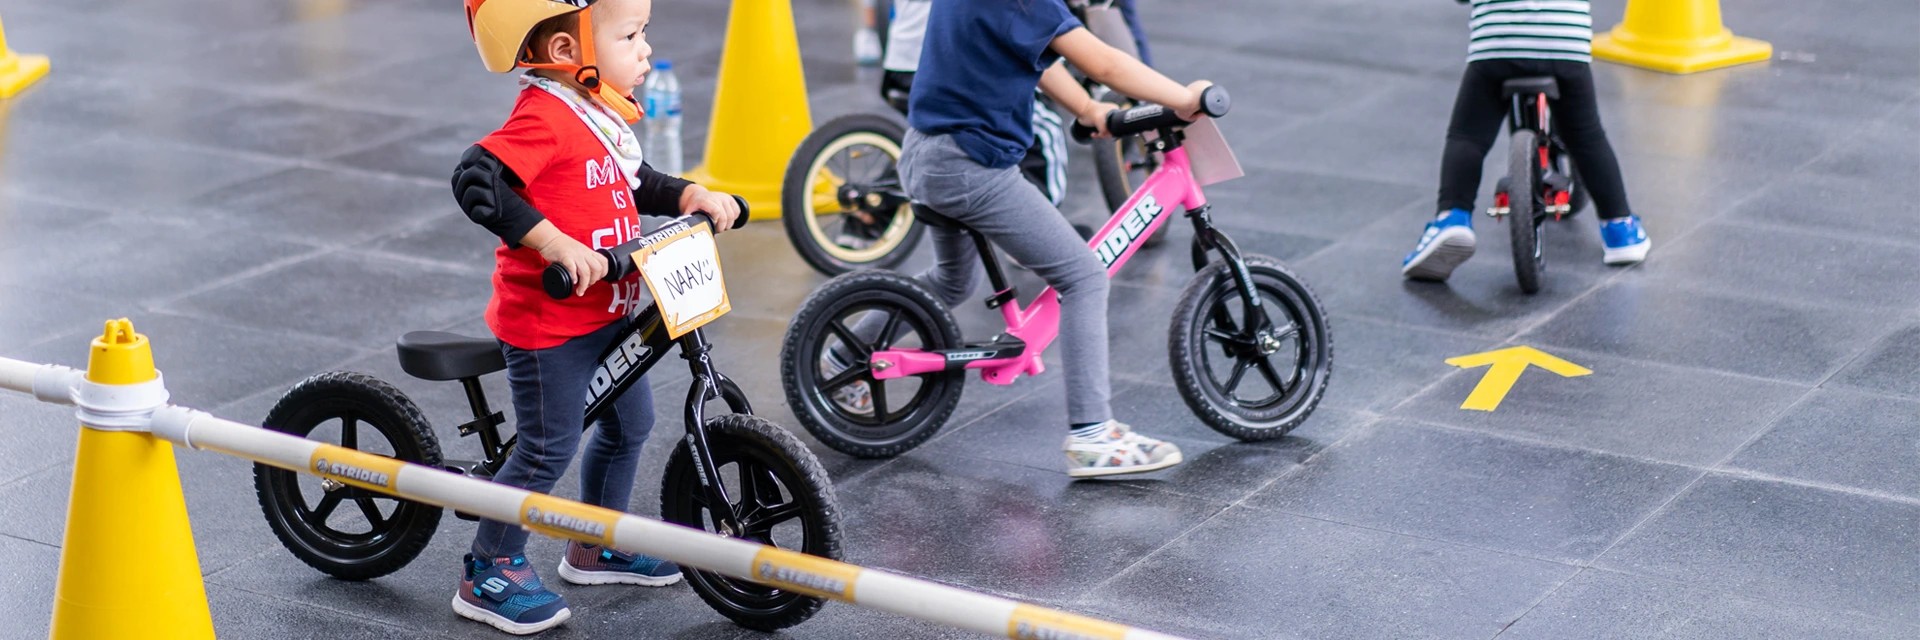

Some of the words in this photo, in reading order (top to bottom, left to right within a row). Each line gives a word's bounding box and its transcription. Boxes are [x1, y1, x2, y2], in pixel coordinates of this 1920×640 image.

[585, 331, 652, 410] IDER
[330, 462, 389, 487] STRIDER
[542, 511, 606, 537] STRIDER
